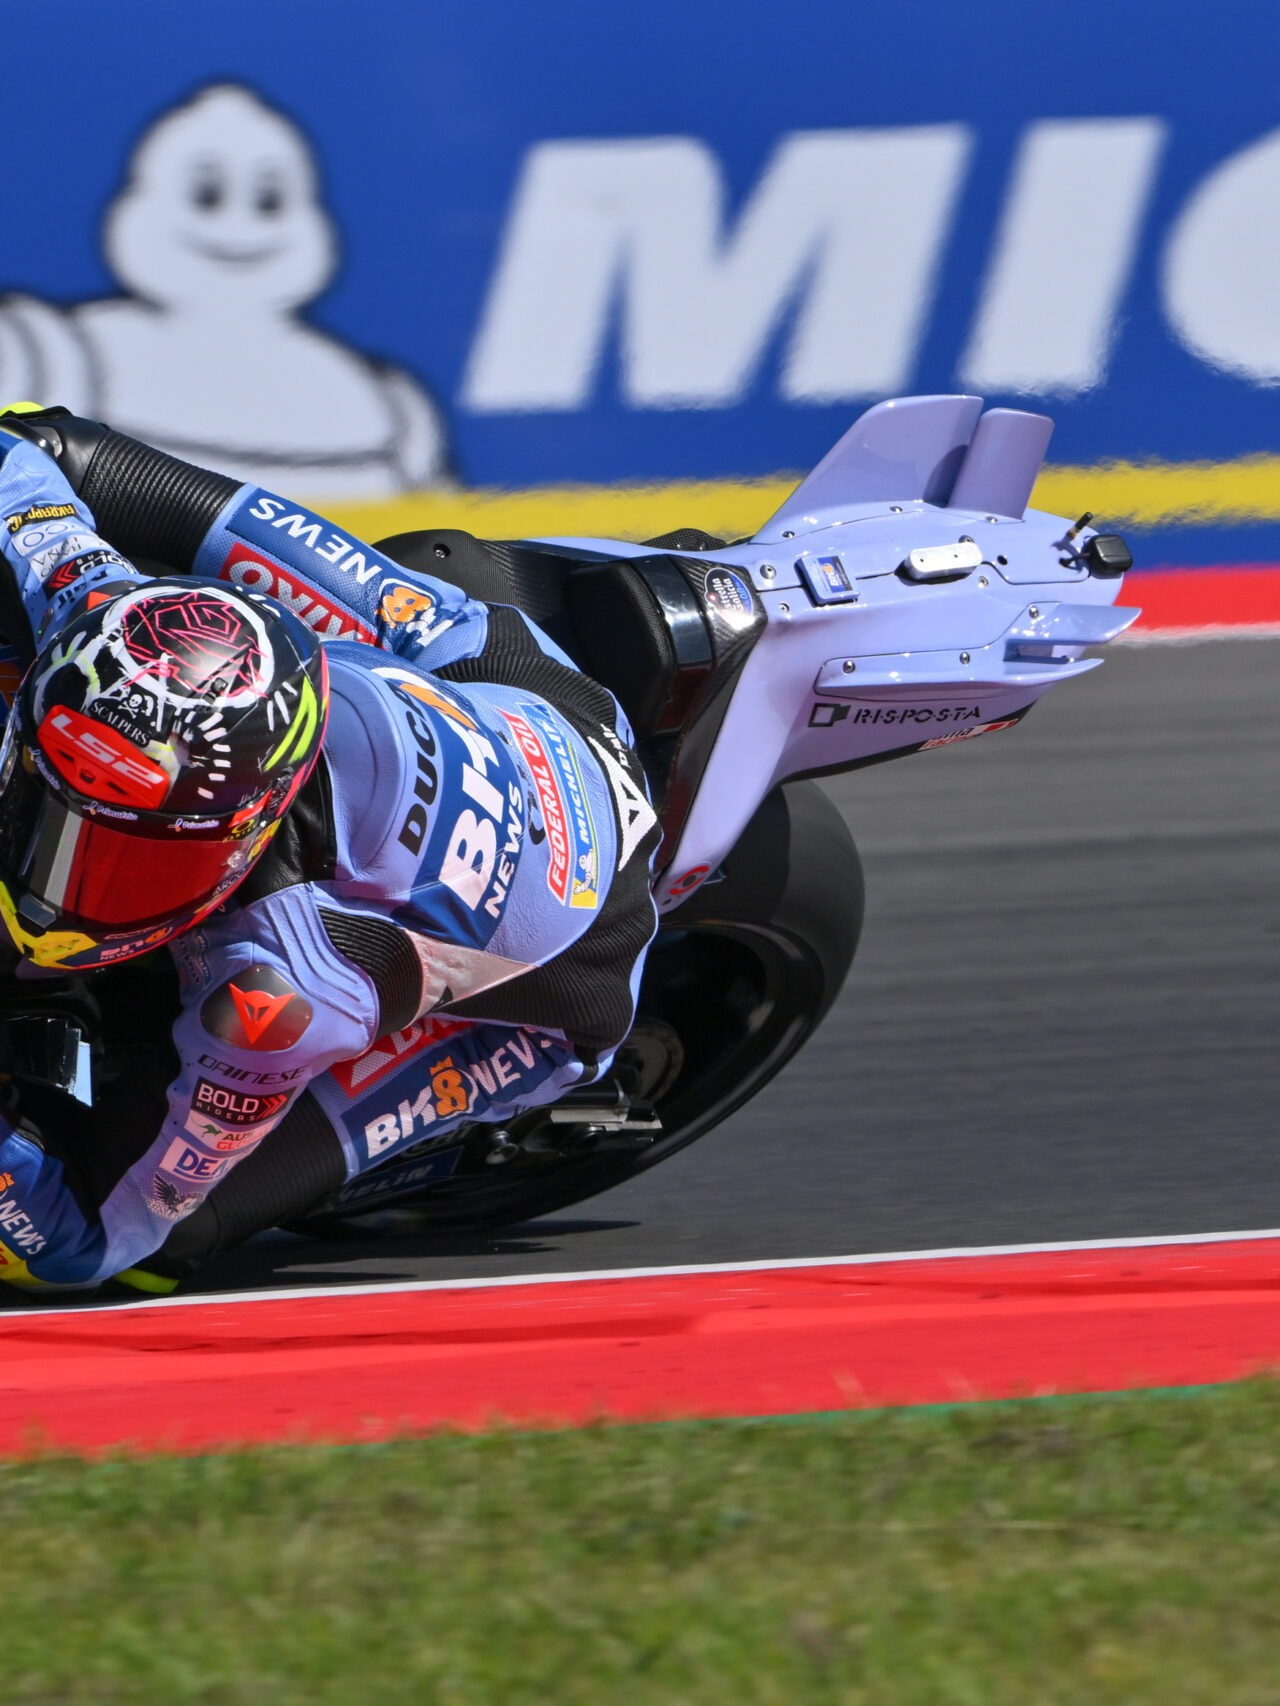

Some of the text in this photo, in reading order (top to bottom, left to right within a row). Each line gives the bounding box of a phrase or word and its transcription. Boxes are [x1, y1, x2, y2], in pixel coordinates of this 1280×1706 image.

[249, 498, 382, 585] NEWS
[50, 713, 164, 789] LS2
[91, 701, 148, 745] SCALPERS
[511, 717, 568, 888] FEDERAL OIL
[485, 782, 524, 919] NEWS
[197, 1054, 310, 1085] DAINESE
[197, 1083, 259, 1113] BOLD
[367, 1056, 477, 1158] BK8
[196, 1102, 255, 1122] RIDERS
